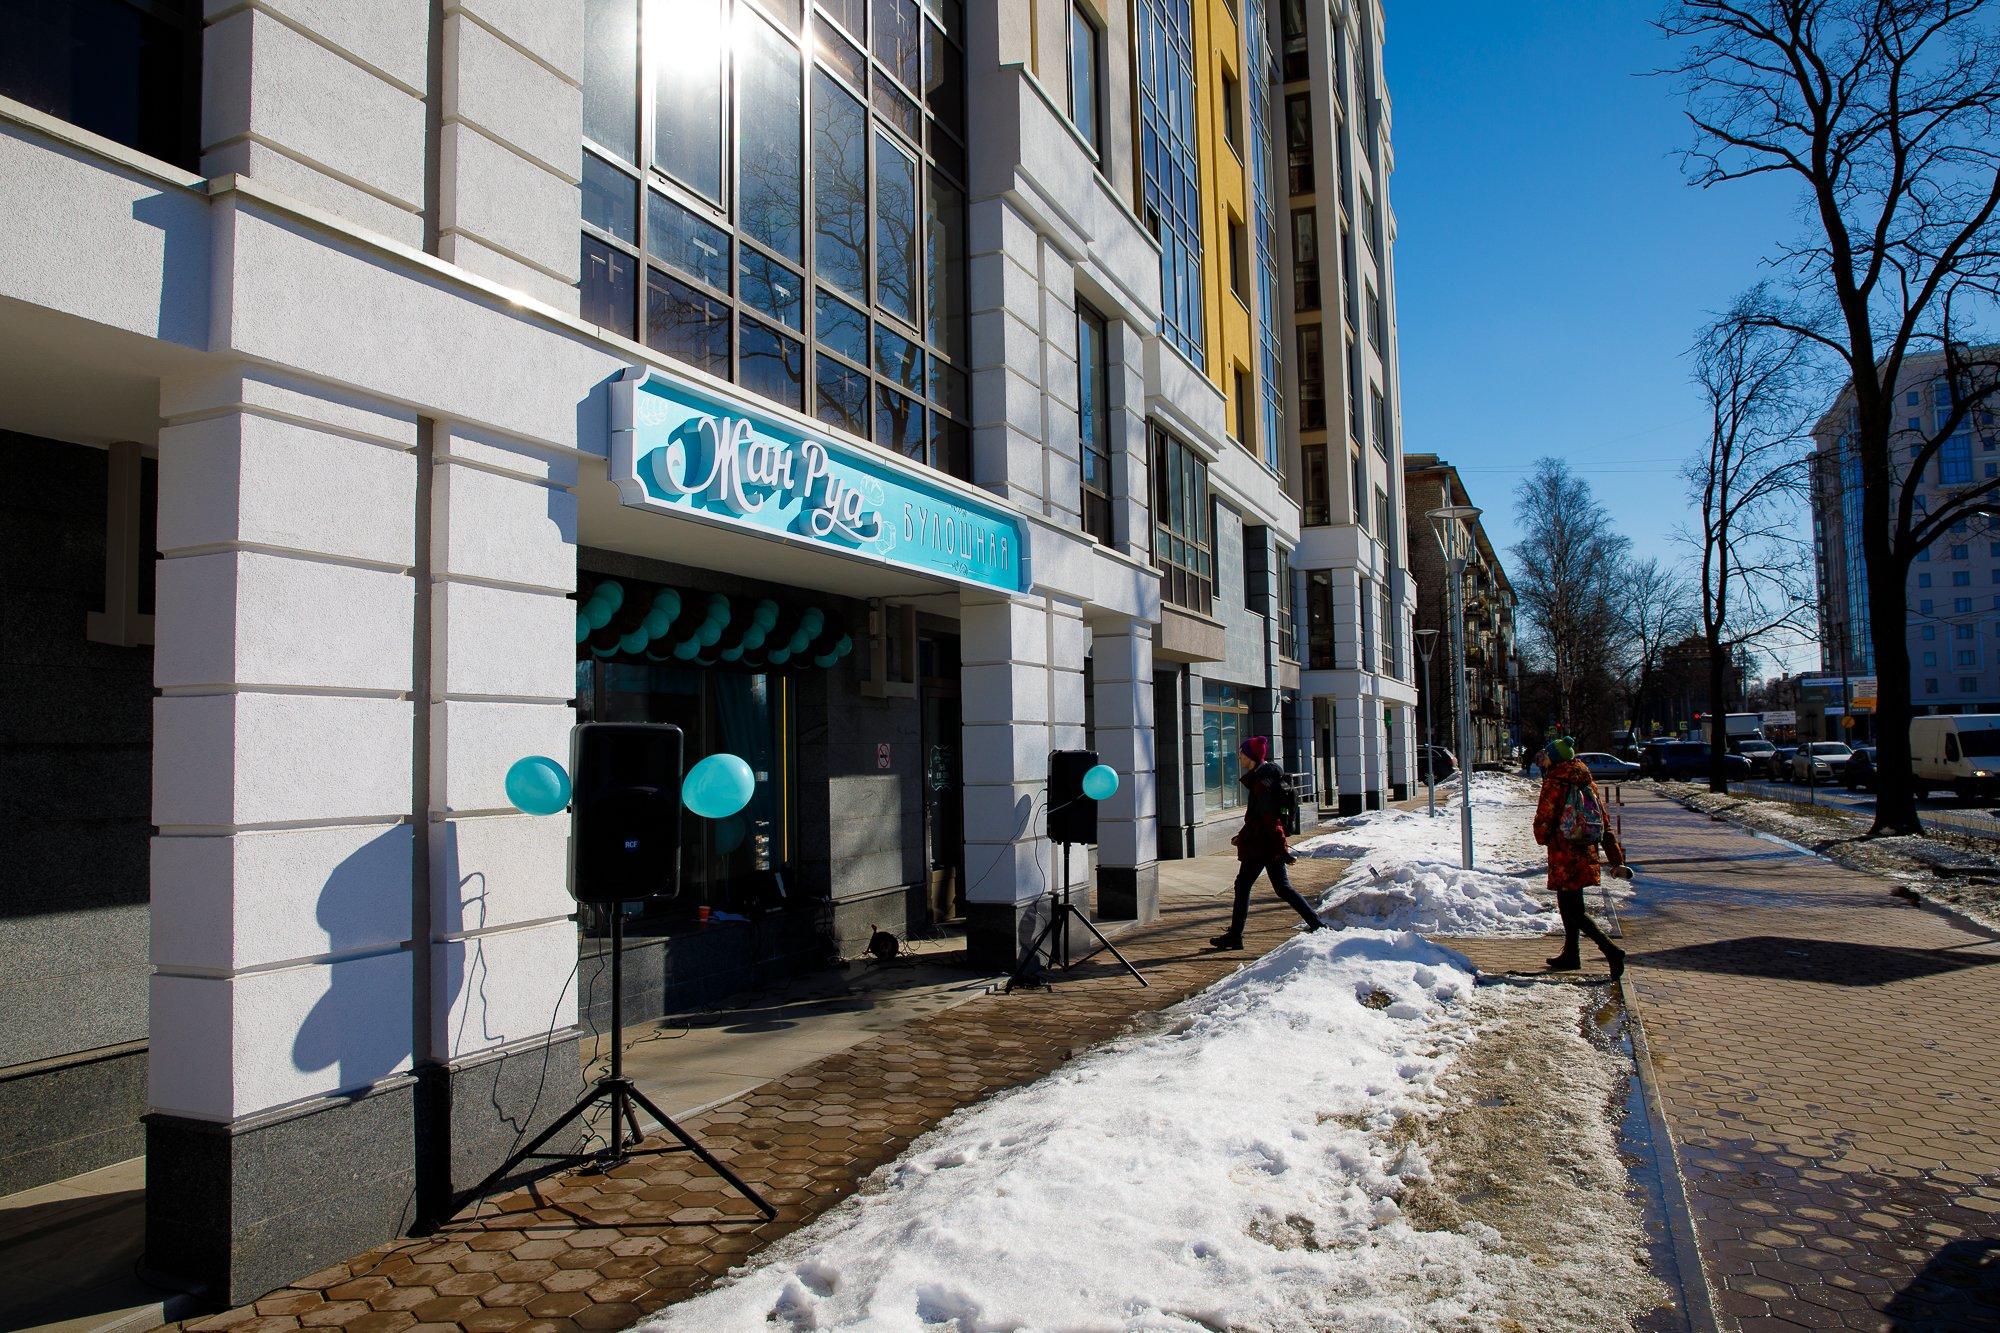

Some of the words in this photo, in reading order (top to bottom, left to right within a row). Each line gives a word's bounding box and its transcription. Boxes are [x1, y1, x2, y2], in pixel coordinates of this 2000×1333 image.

[666, 416, 795, 513] Жан
[802, 439, 882, 542] Руа
[903, 501, 1009, 571] БУЛОШНАЯ
[624, 840, 639, 849] RCF
